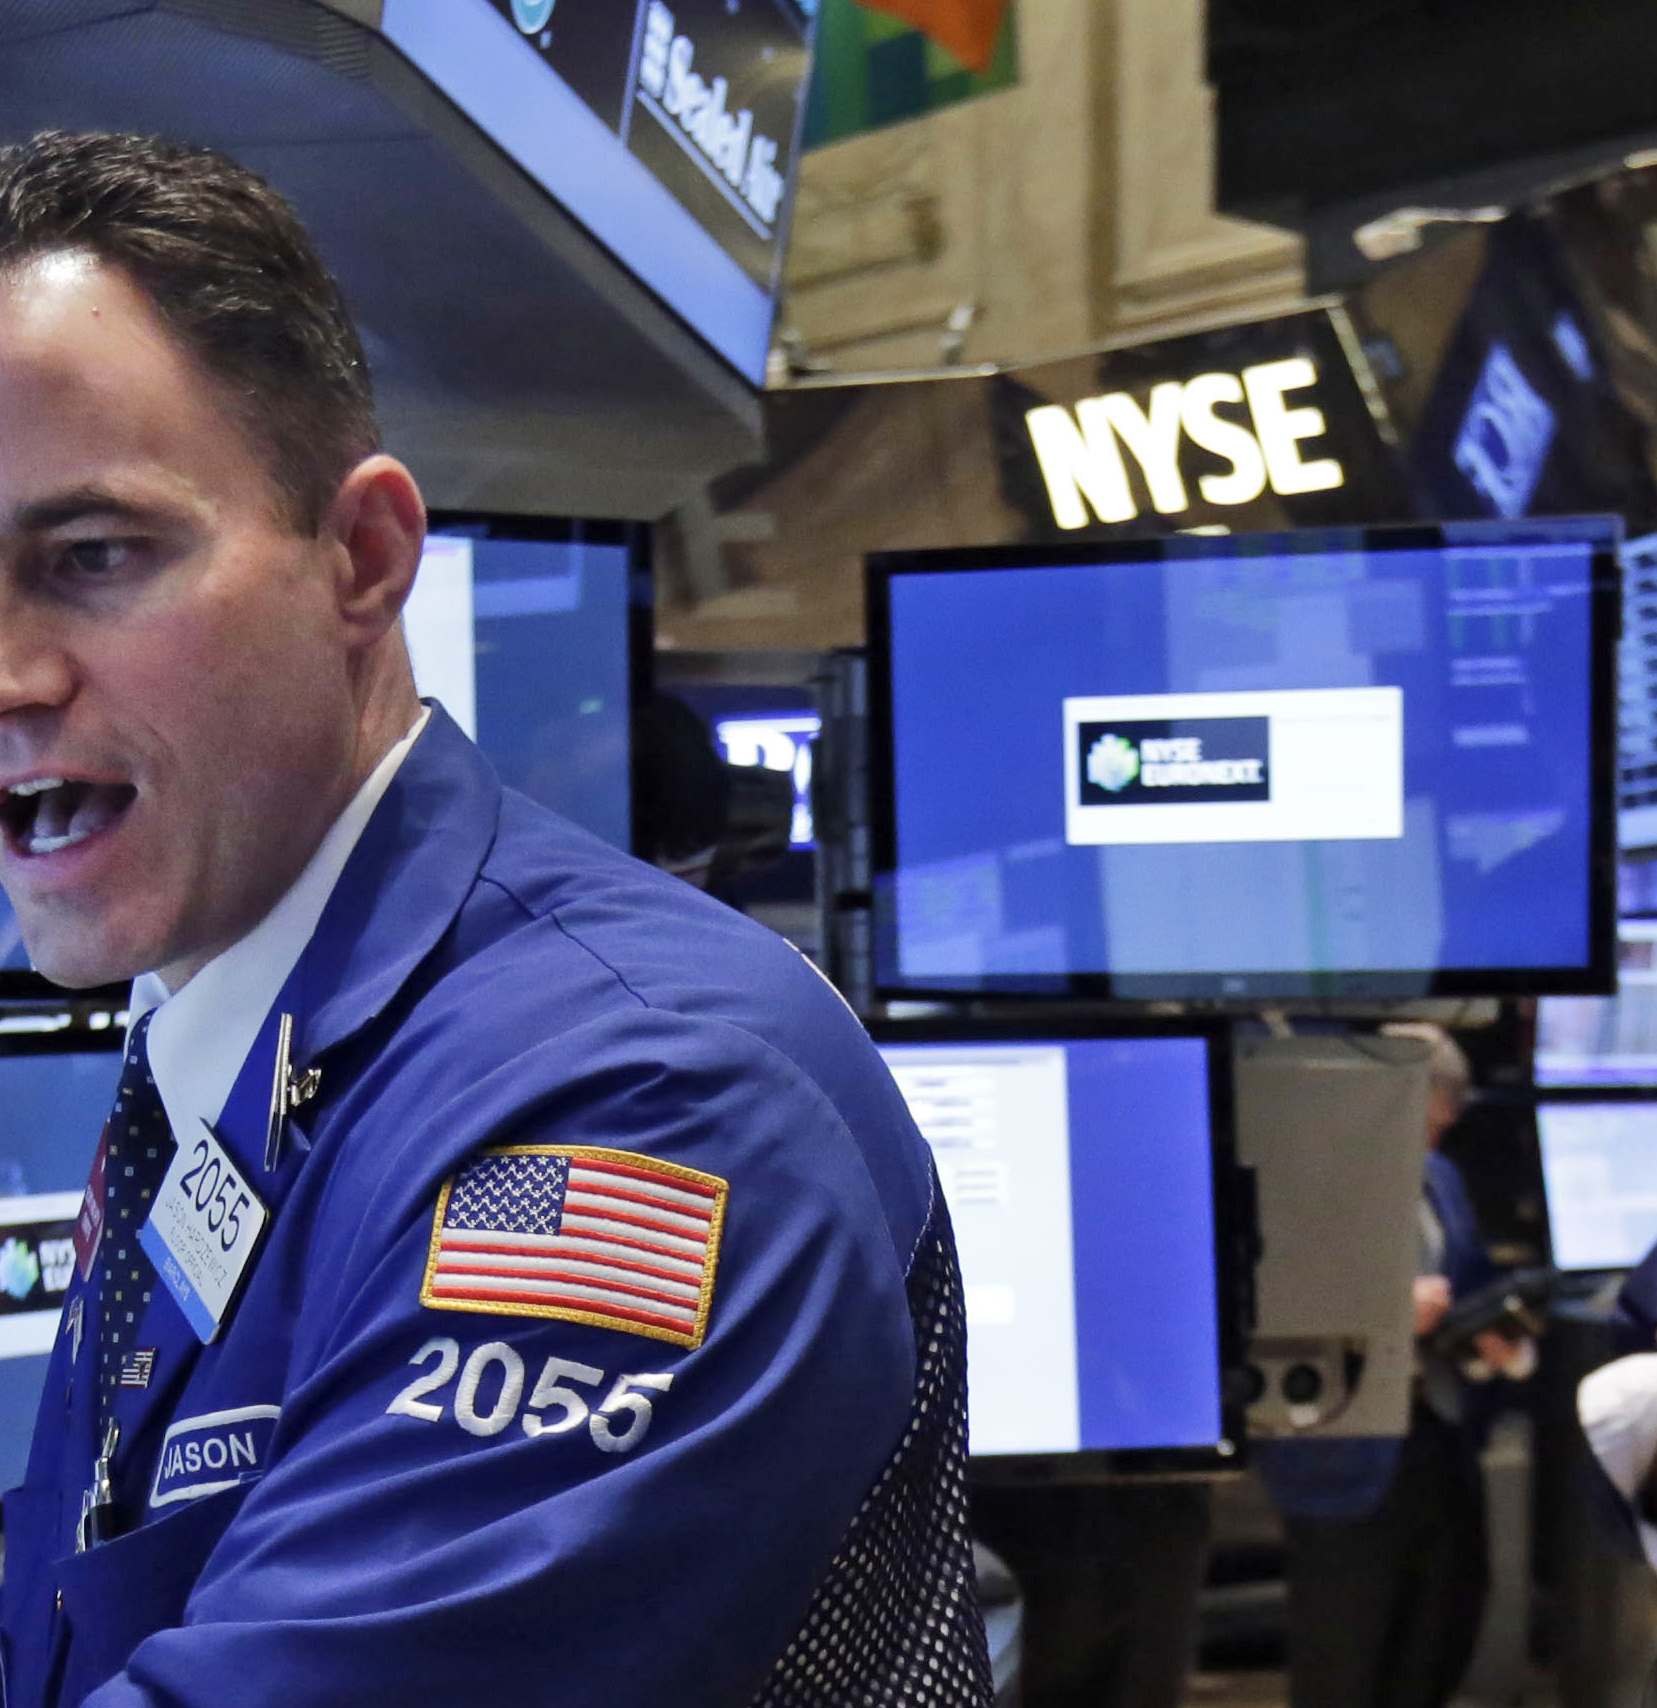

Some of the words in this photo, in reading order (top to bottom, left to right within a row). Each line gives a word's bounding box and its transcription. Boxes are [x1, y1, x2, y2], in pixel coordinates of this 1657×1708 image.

[1025, 357, 1344, 530] NYSE
[180, 1139, 250, 1252] 2055
[385, 1337, 674, 1452] 2055
[164, 1431, 257, 1480] JASON
